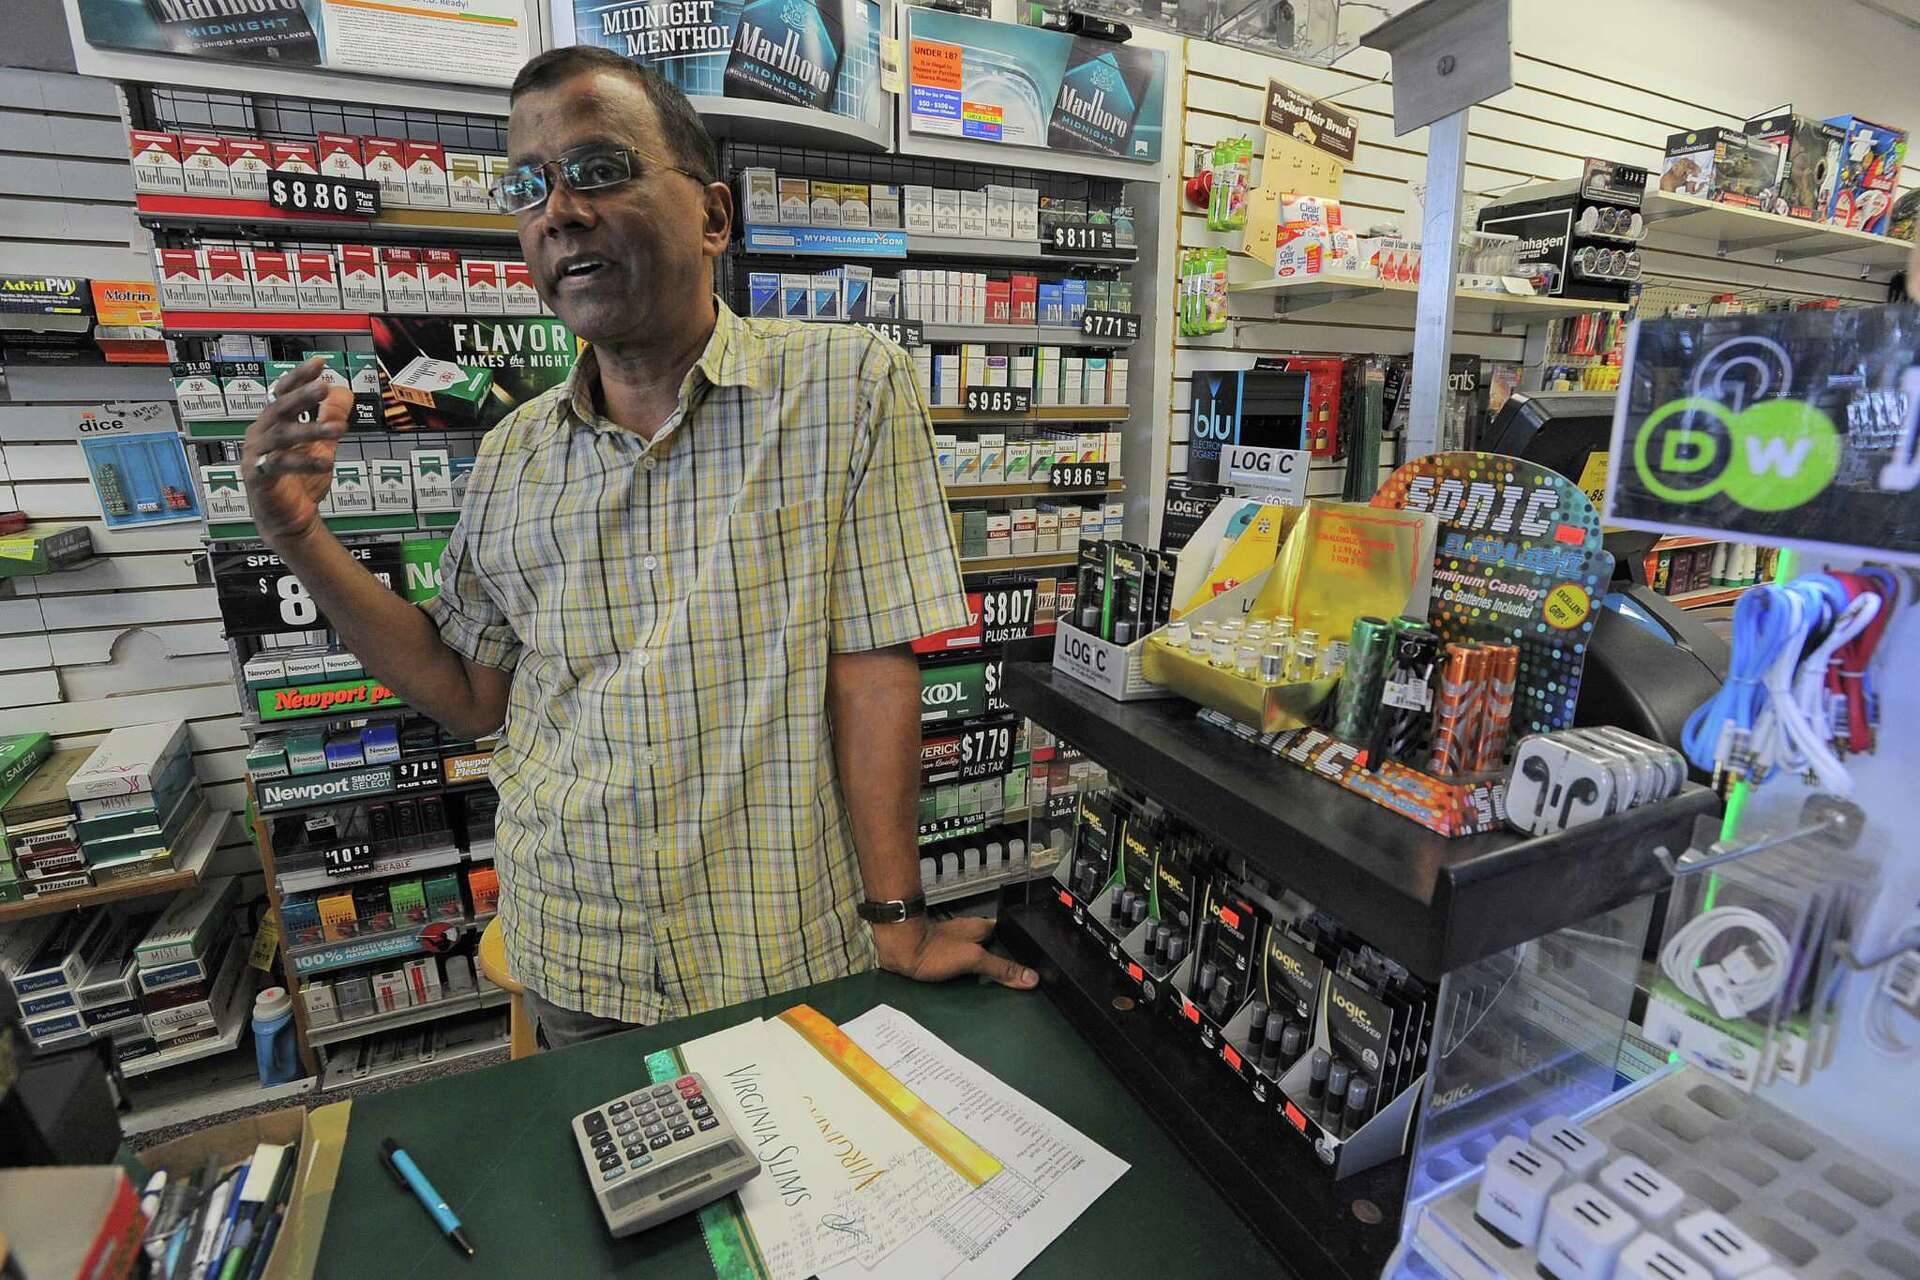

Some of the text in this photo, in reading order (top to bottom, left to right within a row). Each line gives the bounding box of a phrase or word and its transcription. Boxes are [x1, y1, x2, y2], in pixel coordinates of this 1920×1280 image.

[602, 0, 715, 35] MIDNIGHT
[185, 17, 289, 38] MIDNIGHT
[202, 39, 234, 48] UNIQUE
[235, 36, 277, 45] MENTHOL
[278, 31, 311, 40] FLAVOR
[625, 25, 734, 57] MENTHOL
[736, 21, 830, 93] Marlboro
[915, 47, 958, 59] UNDER 18?
[743, 62, 816, 100] MIDNIGHT
[1057, 84, 1127, 137] Marlboro
[1272, 93, 1304, 117] Pocket
[1304, 107, 1325, 126] Hair
[1325, 117, 1352, 139] Brush
[1062, 115, 1115, 145] MIDNIGHT
[1670, 142, 1709, 155] Smithsonian
[137, 169, 181, 187] Marlboro
[187, 171, 228, 189] Marlboro
[412, 177, 445, 195] Marlboro
[355, 190, 374, 199] Plus
[357, 199, 373, 207] Tax
[1300, 202, 1319, 213] Clear
[1302, 212, 1319, 222] eyes
[1056, 227, 1095, 248] $8.11
[1520, 235, 1564, 255] nhagen
[104, 288, 151, 301] Motrin
[164, 284, 206, 301] Marlboro
[211, 284, 250, 302] Marlboro
[257, 286, 296, 303] Marlboro
[301, 286, 338, 304] Marlboro
[344, 283, 381, 300] Marlboro
[386, 284, 423, 301] Marlboro
[428, 286, 462, 302] Marlboro
[469, 290, 499, 303] Marlboro
[506, 290, 536, 304] Marlboro
[1085, 315, 1121, 337] $7.71
[453, 323, 568, 354] FLAVOR
[186, 361, 211, 371] $1.00
[235, 362, 259, 372] $1.00
[457, 354, 572, 368] MAKES the NIGHT.
[184, 394, 222, 411] Marlboro
[356, 403, 374, 411] Plus
[969, 392, 1011, 411] $9.65
[79, 419, 124, 432] dice
[1194, 398, 1231, 440] blu
[1663, 431, 1813, 478] D W
[1053, 468, 1092, 486] $9.86
[337, 493, 367, 507] Marlboro
[379, 492, 408, 504] Marlboro
[420, 485, 448, 498] Marlboro
[212, 500, 245, 514] Marlboro
[1404, 476, 1560, 537] SONIC
[1434, 568, 1539, 601] uminum Casing
[984, 589, 1032, 626] $8.07
[1455, 589, 1534, 618] Batteries Included
[1555, 589, 1585, 617] EXCELLENT
[985, 627, 1027, 643] PLUS TAX
[288, 663, 320, 673] Newport
[327, 659, 359, 668] Newport
[248, 668, 281, 677] Newport
[274, 685, 367, 710] Newport
[369, 745, 398, 755] Newport
[962, 728, 1009, 764] $7.79
[293, 753, 323, 763] Newport
[331, 759, 362, 769] Newport
[5, 751, 37, 783] SALEM
[252, 768, 285, 779] Newport
[963, 760, 1004, 777] PLUS TAX
[265, 771, 391, 803] Newport SMOOTH
[352, 779, 391, 791] SELECT
[396, 777, 439, 788] PLUS TAX
[101, 795, 131, 809] MISTY
[963, 815, 976, 824] PLUS
[24, 831, 68, 846] Winston
[923, 826, 979, 842] SALEM
[35, 854, 79, 868] Winston
[328, 865, 351, 874] PLUS
[352, 863, 369, 871] TAX
[38, 878, 85, 891] Winston
[150, 948, 179, 961] MISTY
[294, 948, 343, 968] 100%
[1271, 942, 1304, 977] logic.
[1332, 987, 1371, 1025] logic.
[1352, 1017, 1382, 1041] POWER
[723, 1064, 812, 1207] VIRGINIA SLIMS
